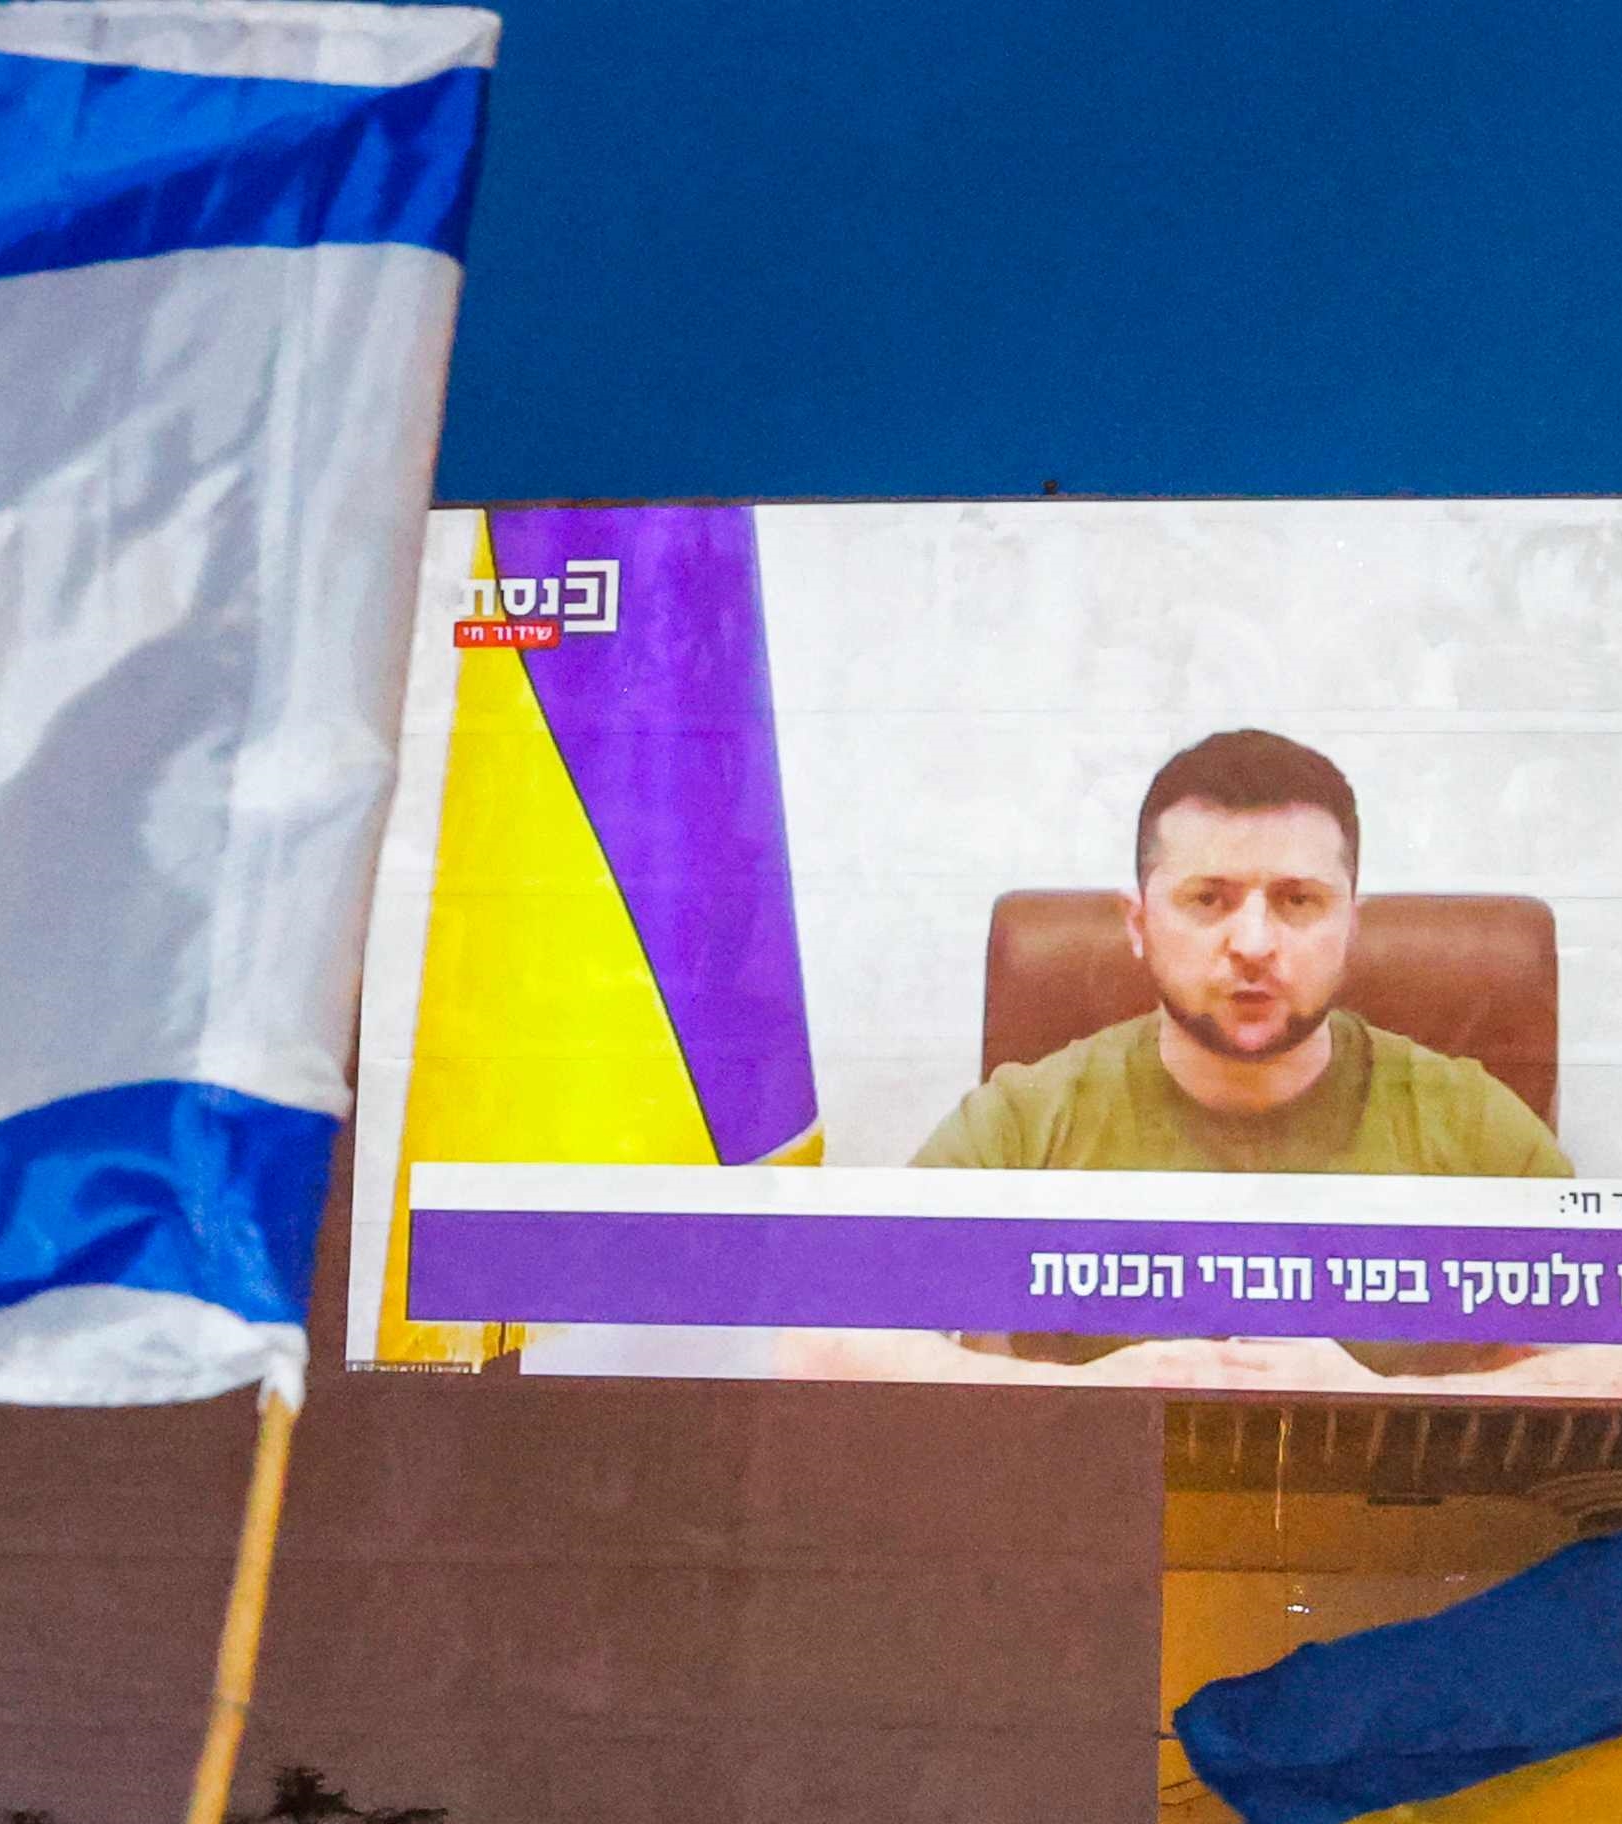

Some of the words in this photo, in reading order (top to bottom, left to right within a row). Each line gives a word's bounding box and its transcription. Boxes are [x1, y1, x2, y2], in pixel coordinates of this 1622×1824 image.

[460, 559, 620, 632] כנסת
[462, 625, 484, 641] חי
[492, 625, 553, 642] שידור
[1559, 1190, 1603, 1215] חי:
[1029, 1251, 1185, 1299] הכנסת
[1197, 1255, 1313, 1301] חברי
[1325, 1256, 1430, 1303] בפני
[1442, 1252, 1604, 1315] זלנסקי
